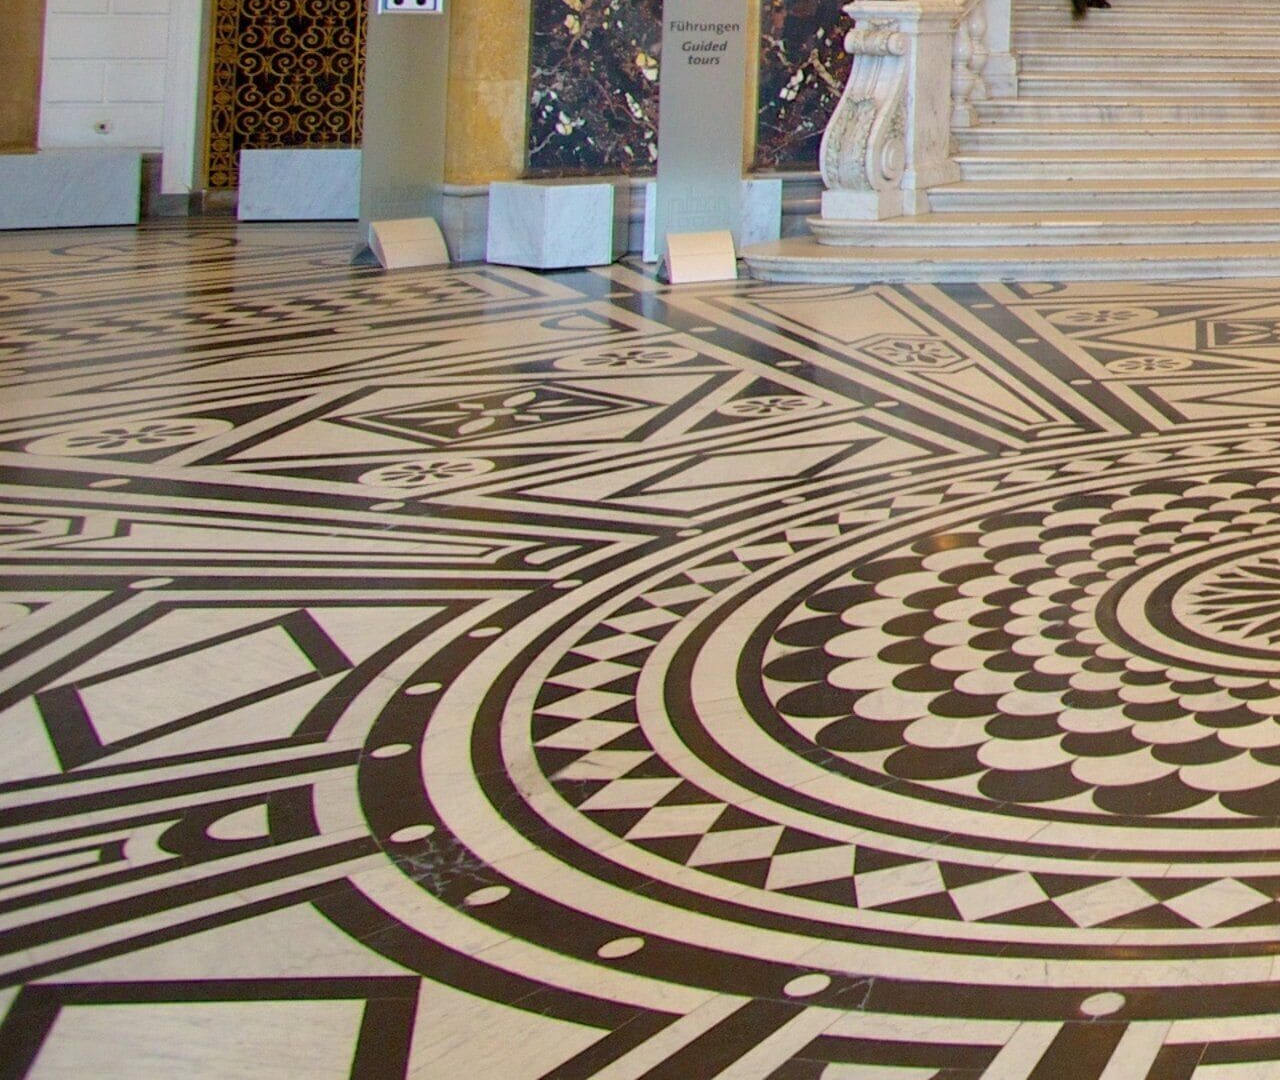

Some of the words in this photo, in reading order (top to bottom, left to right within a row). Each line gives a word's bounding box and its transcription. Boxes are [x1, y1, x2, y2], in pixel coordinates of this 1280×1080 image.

[670, 20, 740, 35] Führungen
[681, 40, 728, 52] Guided
[688, 55, 720, 65] tours
